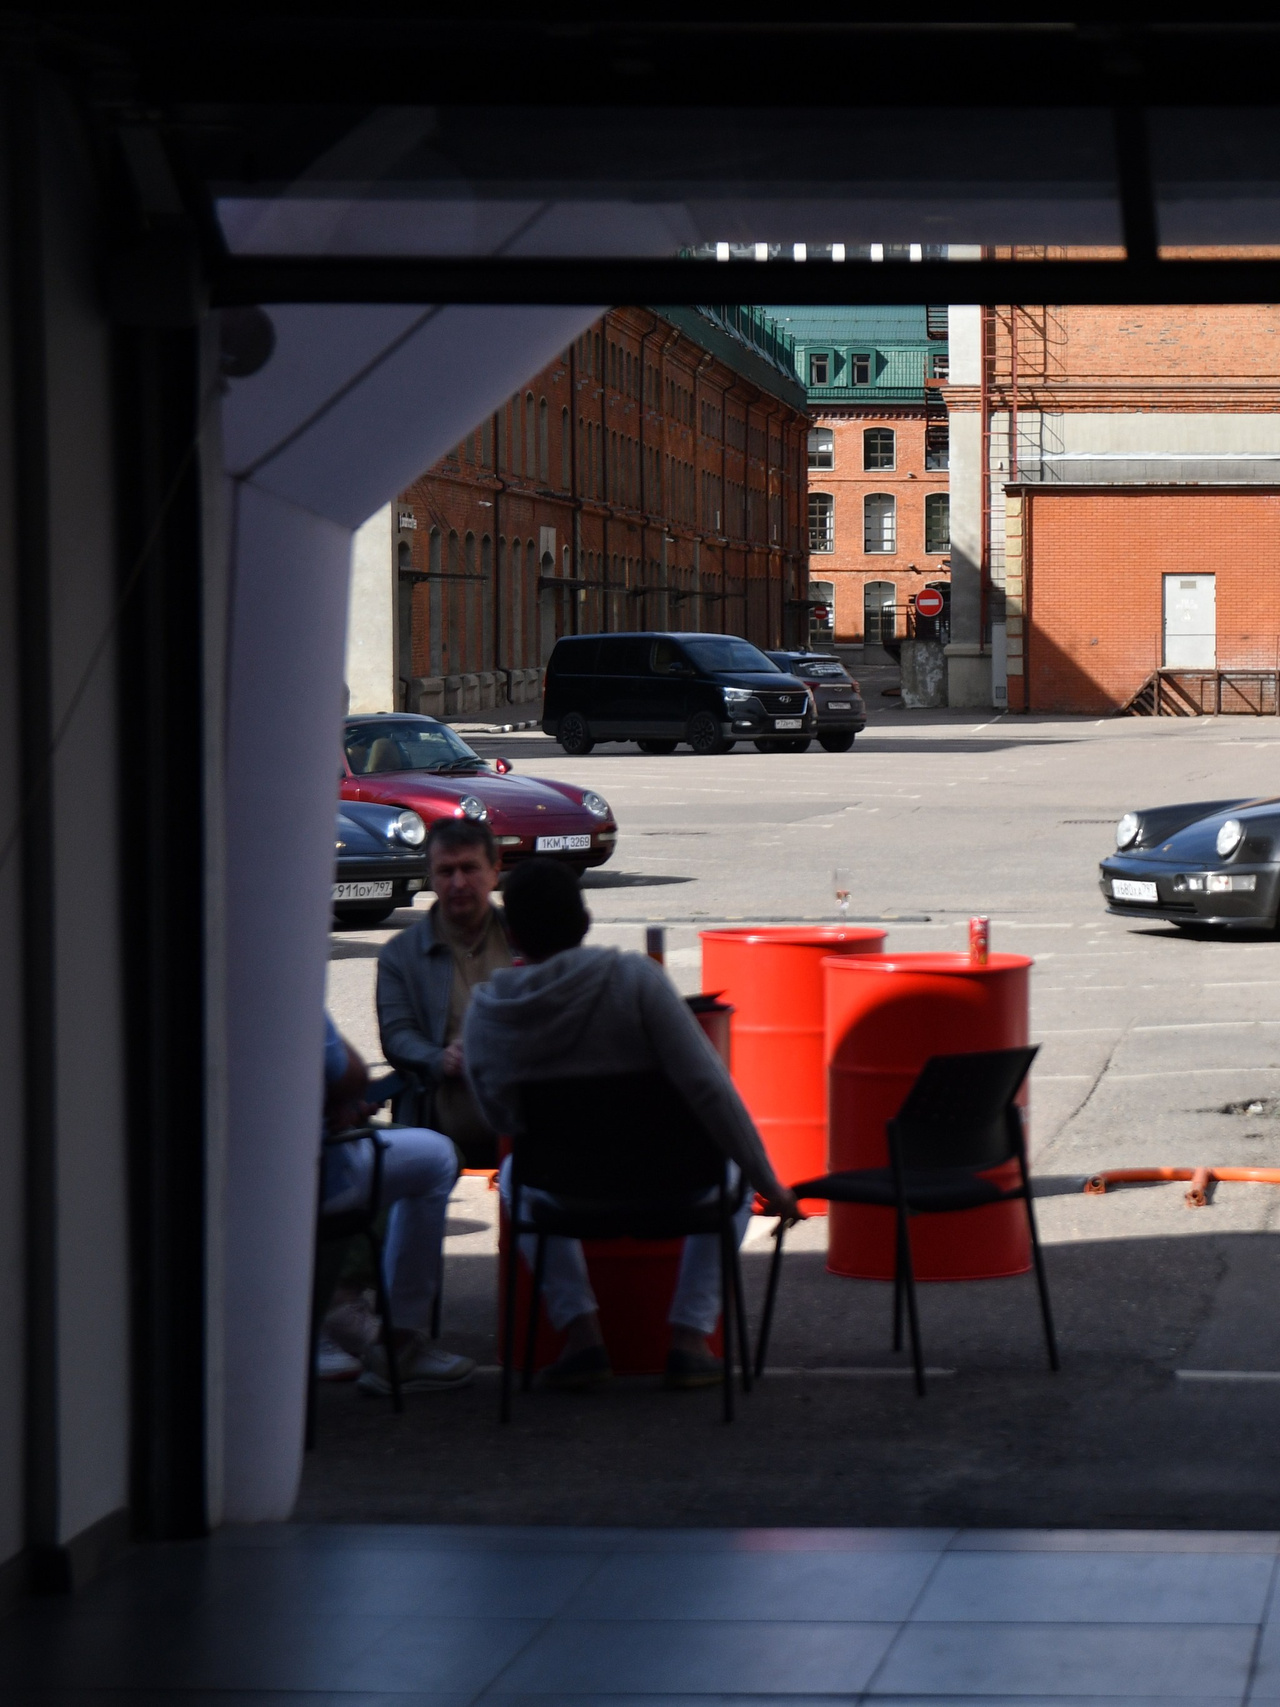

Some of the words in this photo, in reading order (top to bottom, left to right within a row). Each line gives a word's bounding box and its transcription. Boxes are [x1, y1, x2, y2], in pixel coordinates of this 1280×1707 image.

[542, 838, 560, 848] 1KM
[570, 836, 590, 847] 3269
[374, 882, 391, 892] 797
